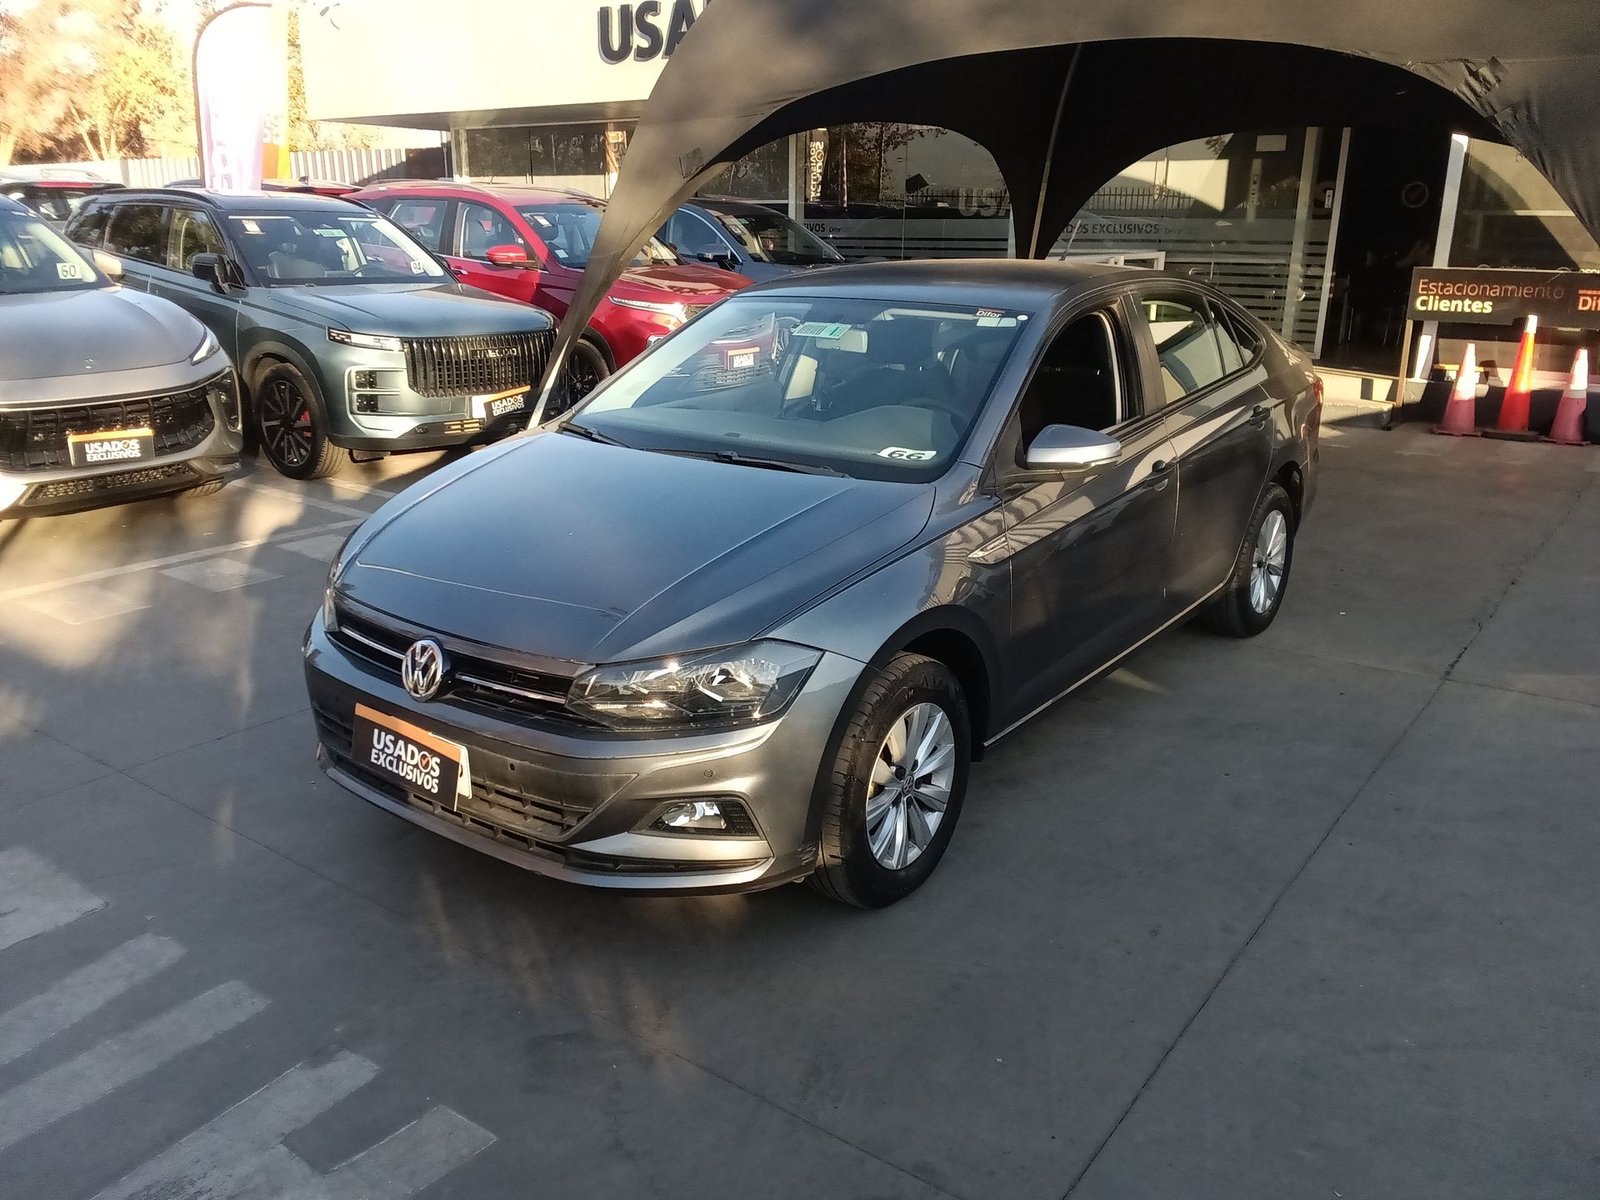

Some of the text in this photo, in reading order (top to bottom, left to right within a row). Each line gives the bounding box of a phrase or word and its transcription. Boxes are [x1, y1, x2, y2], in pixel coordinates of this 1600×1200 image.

[597, 0, 700, 65] USA
[1092, 223, 1160, 234] EXCLUSIVOS
[60, 264, 77, 278] 60
[1418, 279, 1565, 299] Estacionamiento
[1415, 296, 1494, 314] Clientes
[975, 310, 1003, 318] Difor
[490, 394, 524, 411] USADOS
[492, 402, 525, 417] EXCLUSIVOS
[84, 438, 140, 454] USADOS
[86, 449, 142, 462] EXCLUSIVOS
[372, 728, 441, 778] USADOS
[370, 748, 439, 794] EXCLUSIVOS
